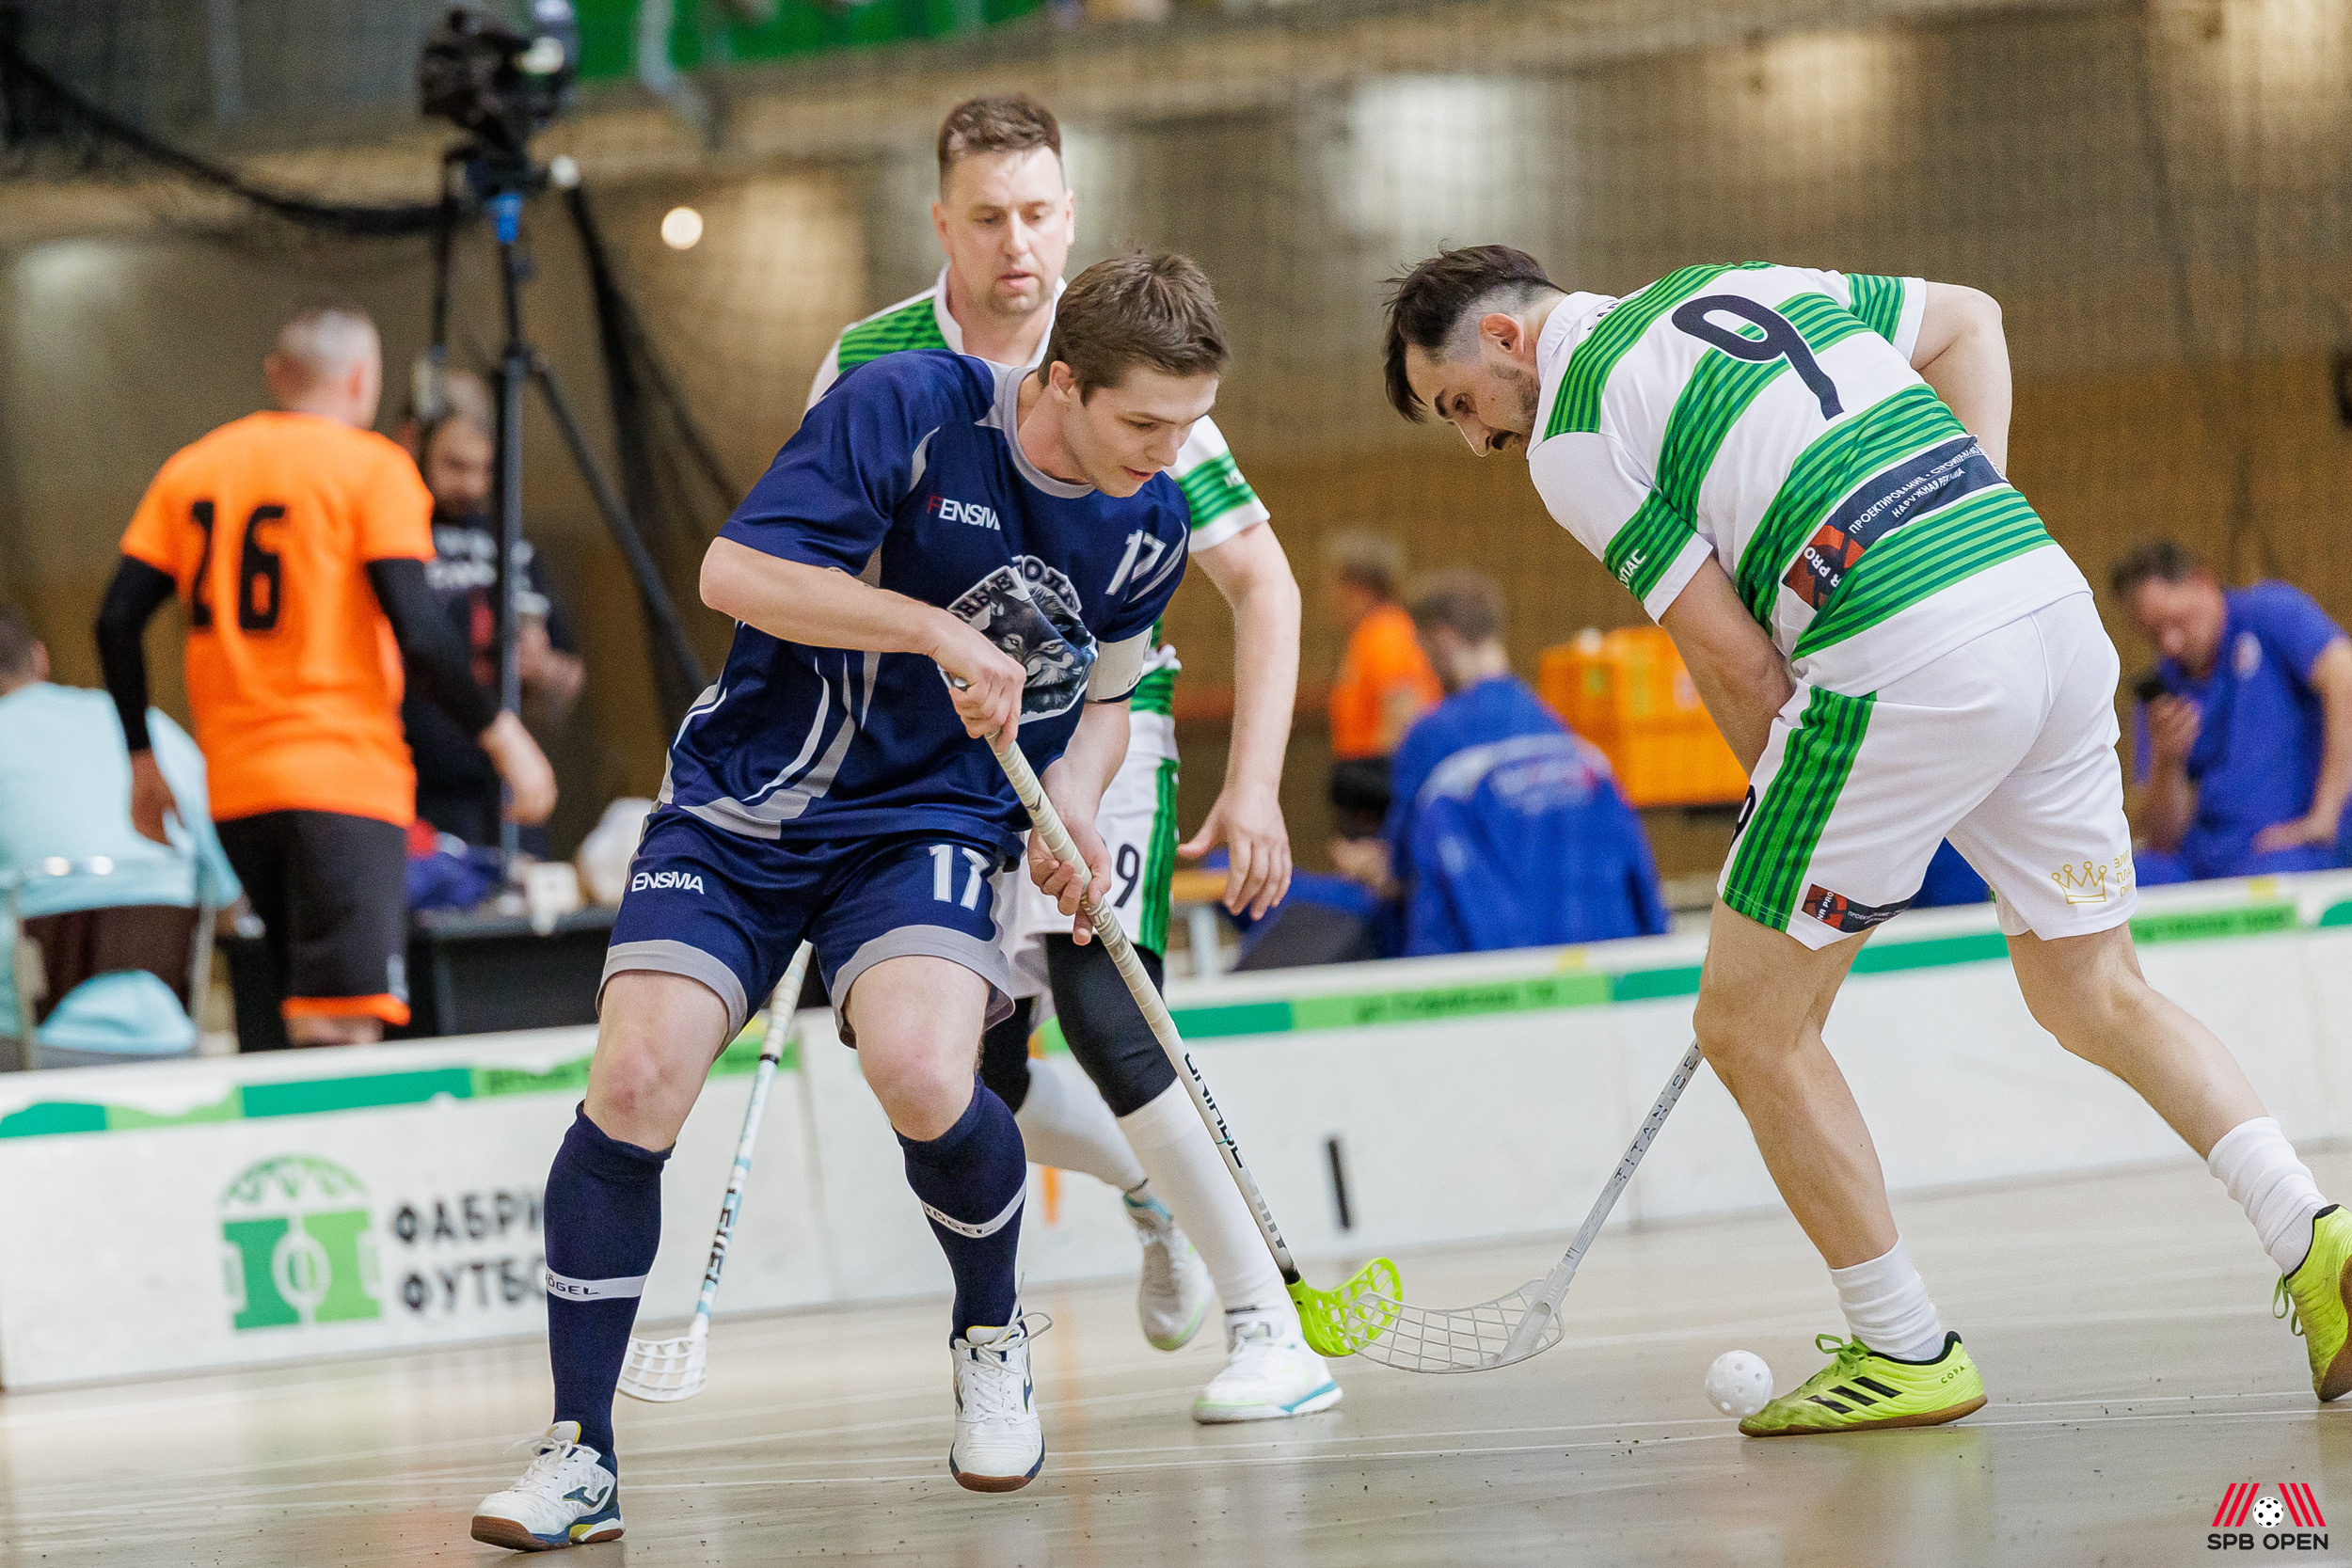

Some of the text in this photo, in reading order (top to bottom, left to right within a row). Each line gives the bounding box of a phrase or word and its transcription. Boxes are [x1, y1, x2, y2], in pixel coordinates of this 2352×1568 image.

[1671, 293, 1846, 421] 9
[926, 495, 1001, 531] FENSM
[1848, 475, 1927, 534] ПРОЕКТИРОВАНИЕ
[1104, 529, 1167, 595] 17
[1804, 546, 1831, 580] PRO
[629, 871, 705, 895] ENSMA
[928, 844, 991, 911] 17
[1113, 843, 1140, 909] 9
[1613, 1043, 1700, 1180] TITAN SE
[389, 1189, 544, 1245] ФАБРИ
[1940, 1365, 1966, 1385] COPA
